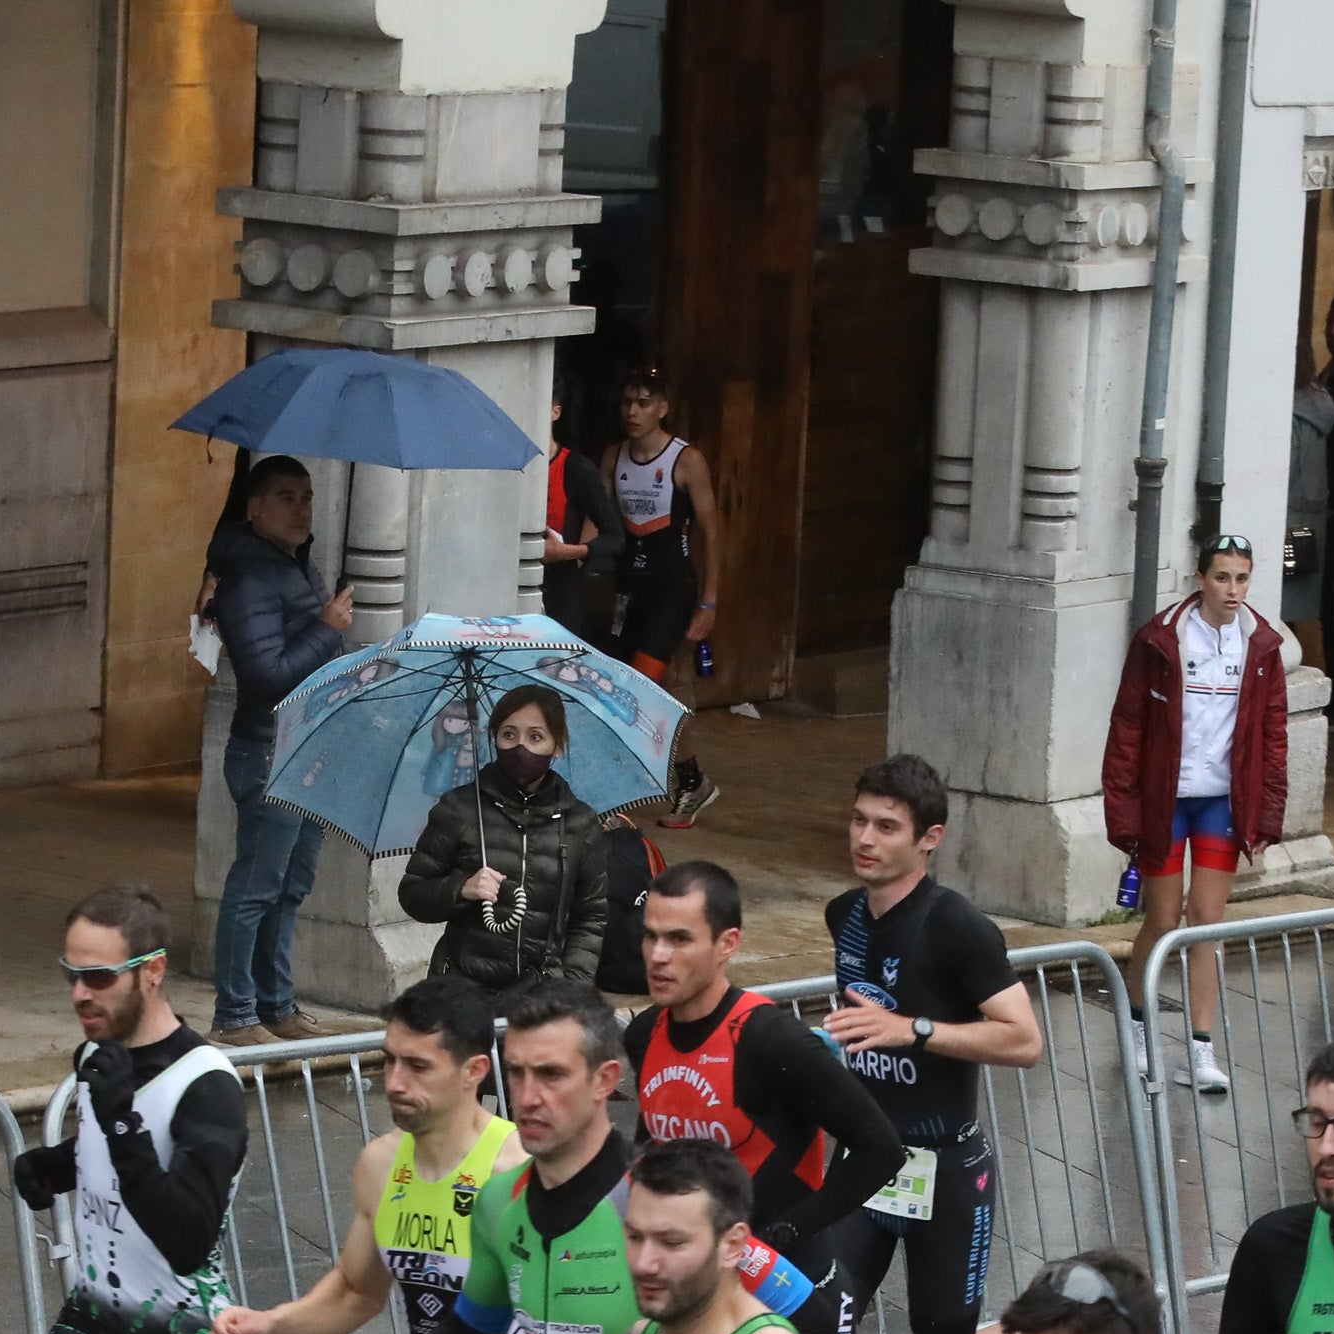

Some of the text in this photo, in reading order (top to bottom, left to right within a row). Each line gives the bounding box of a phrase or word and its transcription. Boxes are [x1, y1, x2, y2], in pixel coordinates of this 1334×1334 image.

[662, 1064, 724, 1108] INFINITY
[391, 1211, 458, 1255] MORLA
[968, 1205, 983, 1266] TRIATLON
[386, 1250, 427, 1272] TRI
[393, 1267, 465, 1291] LEON
